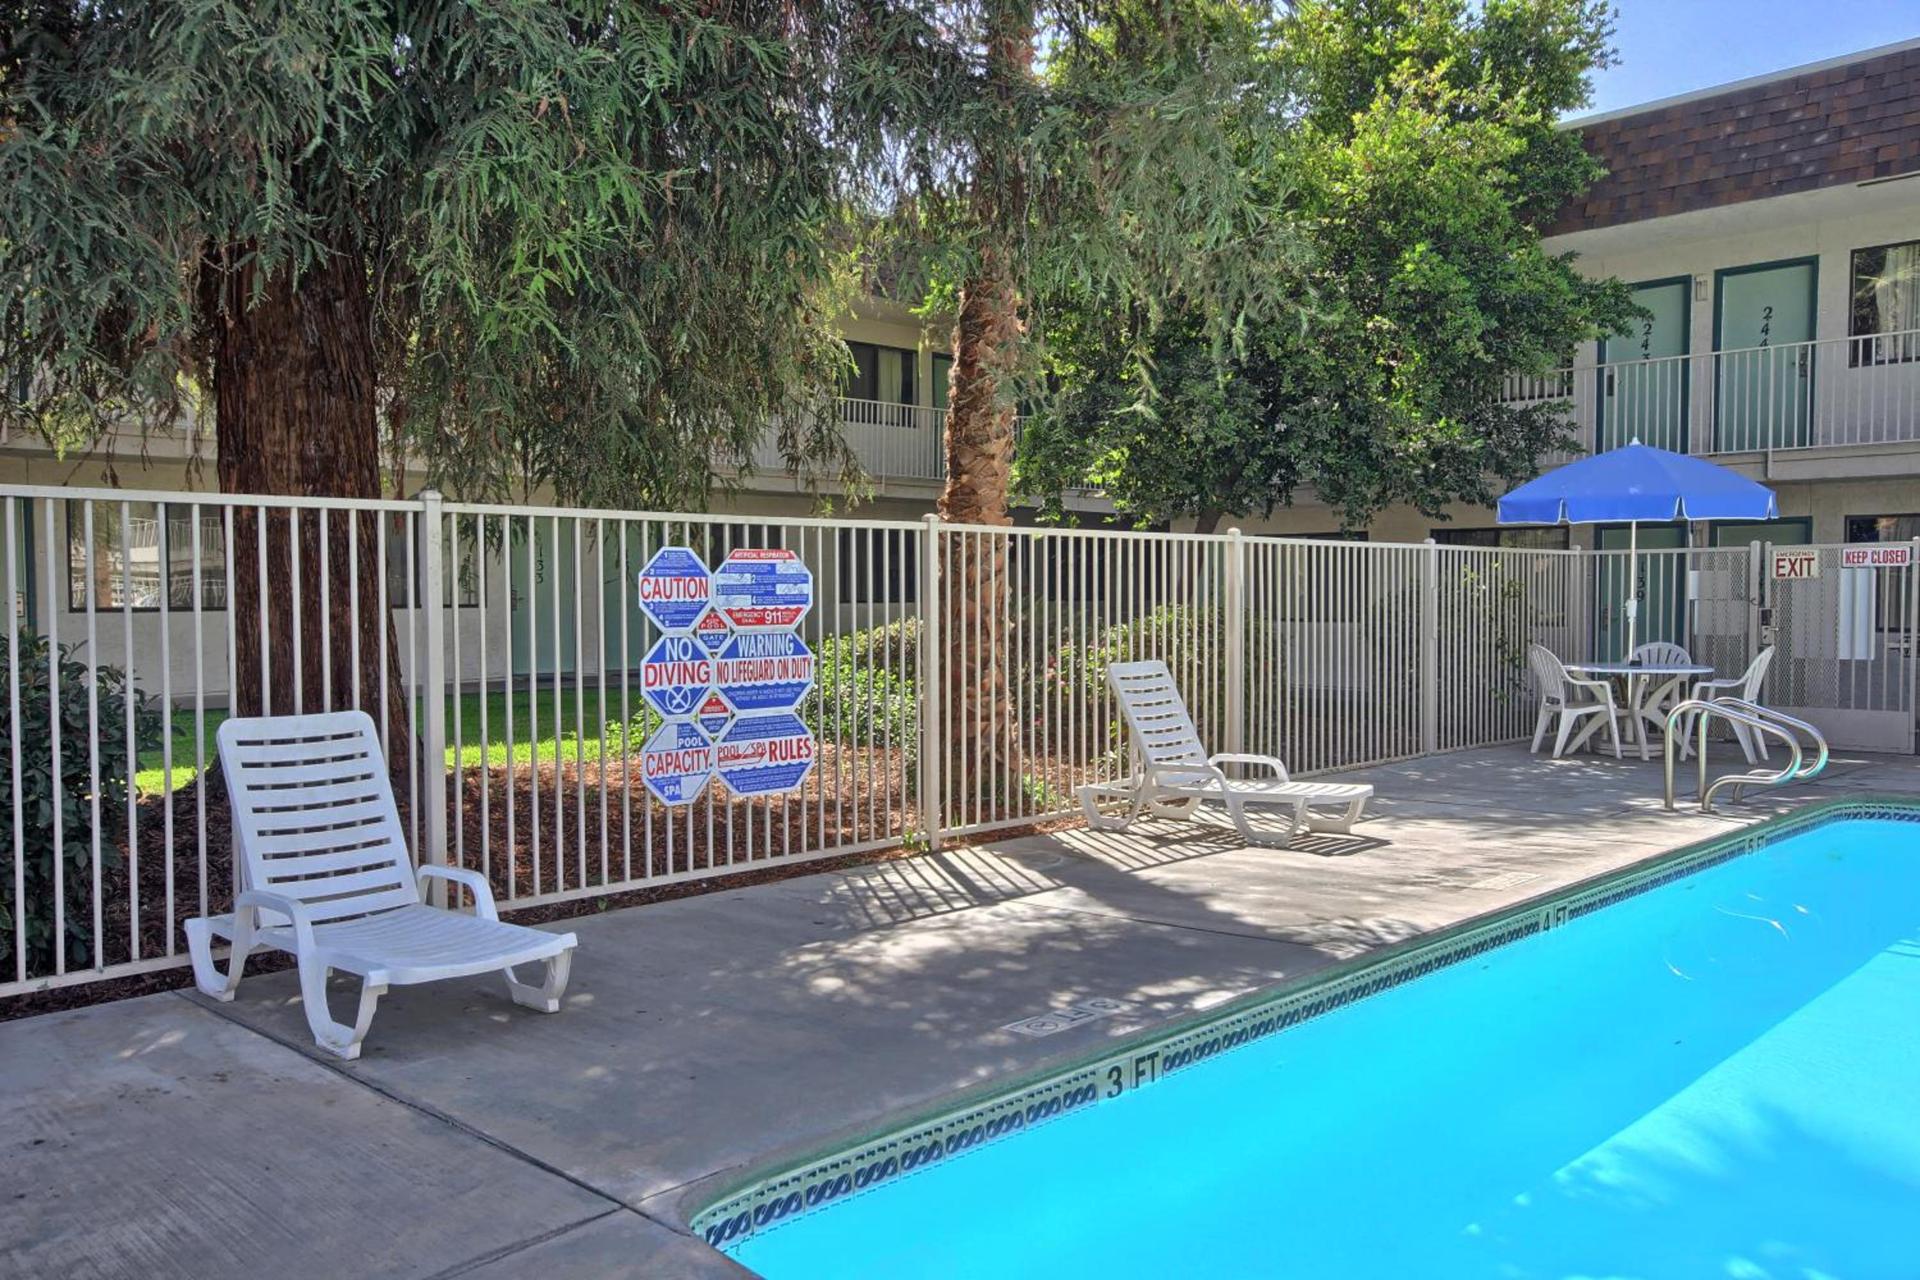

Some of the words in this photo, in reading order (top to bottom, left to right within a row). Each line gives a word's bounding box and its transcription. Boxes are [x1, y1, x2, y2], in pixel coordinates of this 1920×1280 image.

[1776, 557, 1815, 577] EXIT
[1845, 551, 1868, 564] KEEP
[1871, 550, 1907, 563] CLOSED
[640, 577, 708, 600] CAUTION
[764, 611, 783, 624] 911
[665, 637, 693, 662] NO
[737, 634, 795, 658] WARNING
[645, 661, 710, 687] DIVING
[717, 661, 729, 684] NO
[732, 658, 775, 683] LIFEGUARD
[777, 657, 789, 680] ON
[791, 656, 811, 679] DUTY
[678, 737, 703, 747] POOL
[769, 737, 812, 762] RULES
[646, 749, 710, 776] CAPACITY
[664, 784, 680, 797] SPA
[1543, 910, 1550, 931] 4
[1556, 905, 1567, 928] FT
[1107, 1065, 1122, 1099] 3
[1134, 1050, 1160, 1089] FT
